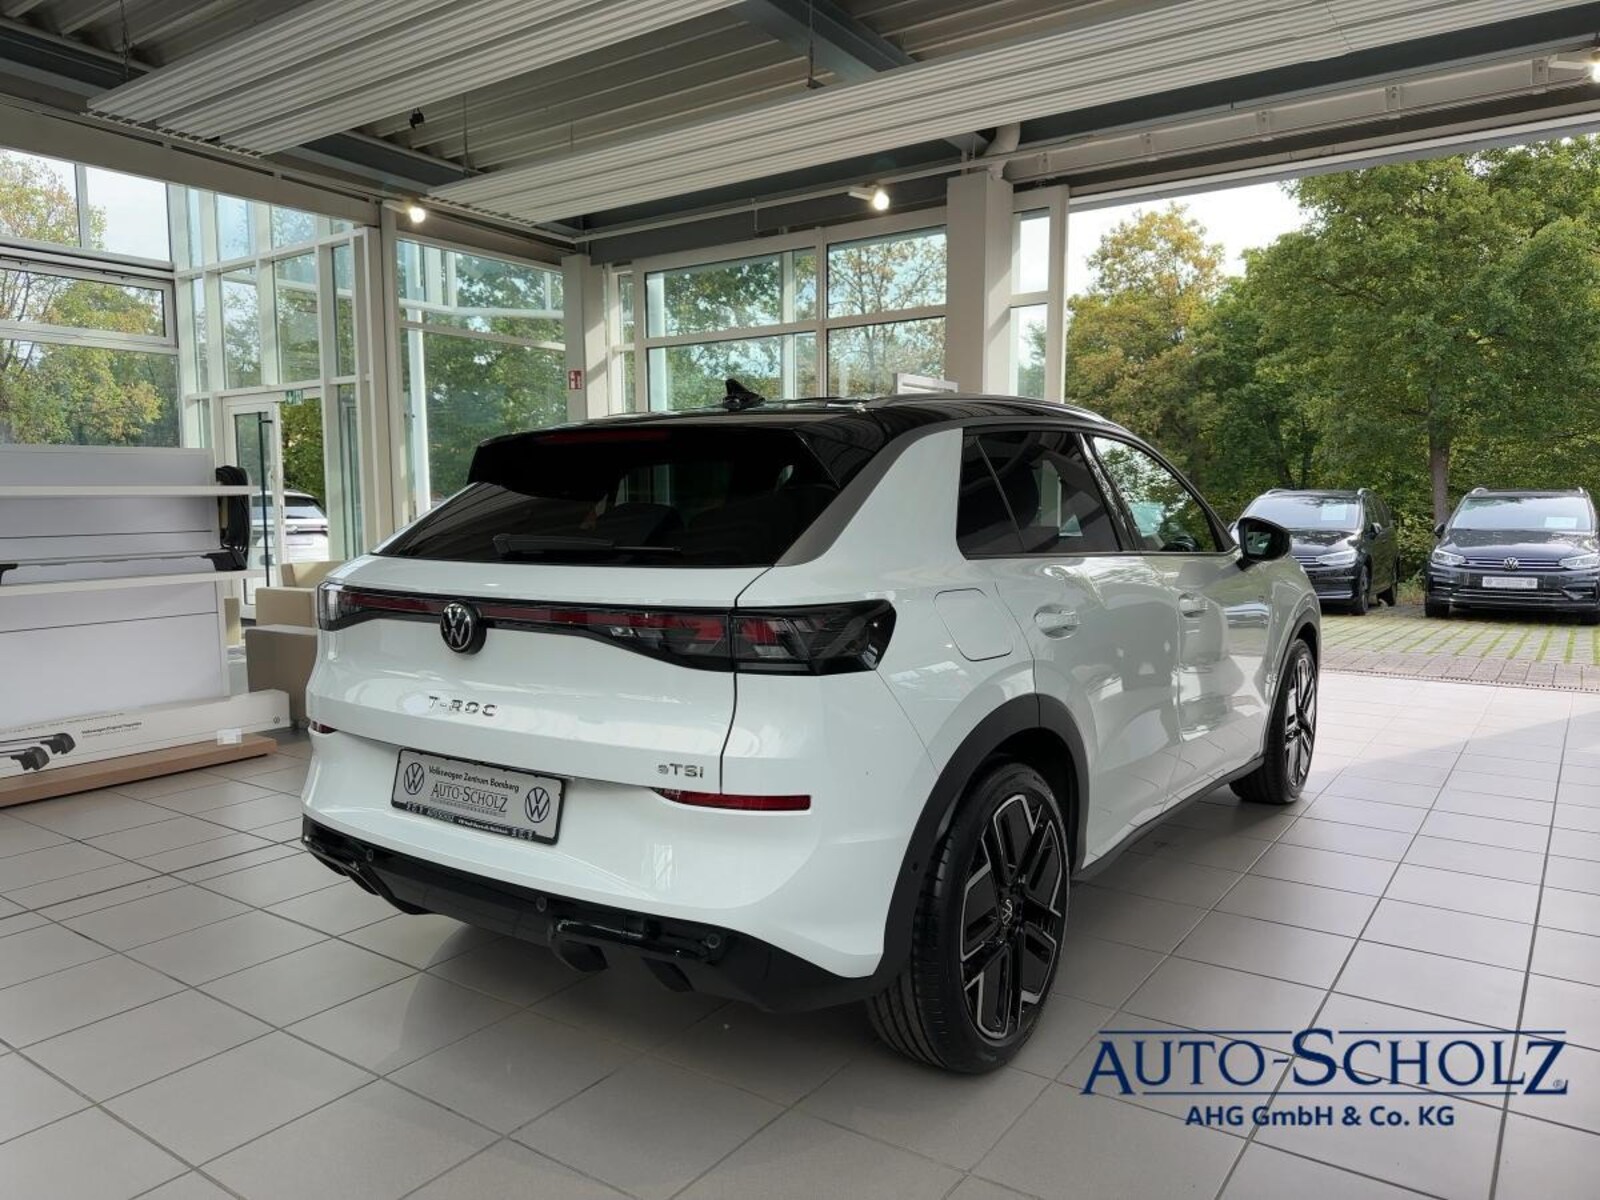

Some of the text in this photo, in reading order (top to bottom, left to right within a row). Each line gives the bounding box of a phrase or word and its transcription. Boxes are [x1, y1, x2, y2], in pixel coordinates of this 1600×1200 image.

[428, 696, 497, 716] T-ROC
[429, 765, 463, 781] Volkswagen
[463, 773, 489, 785] Zentrum
[430, 783, 508, 813] AUTO-SCHOLZ
